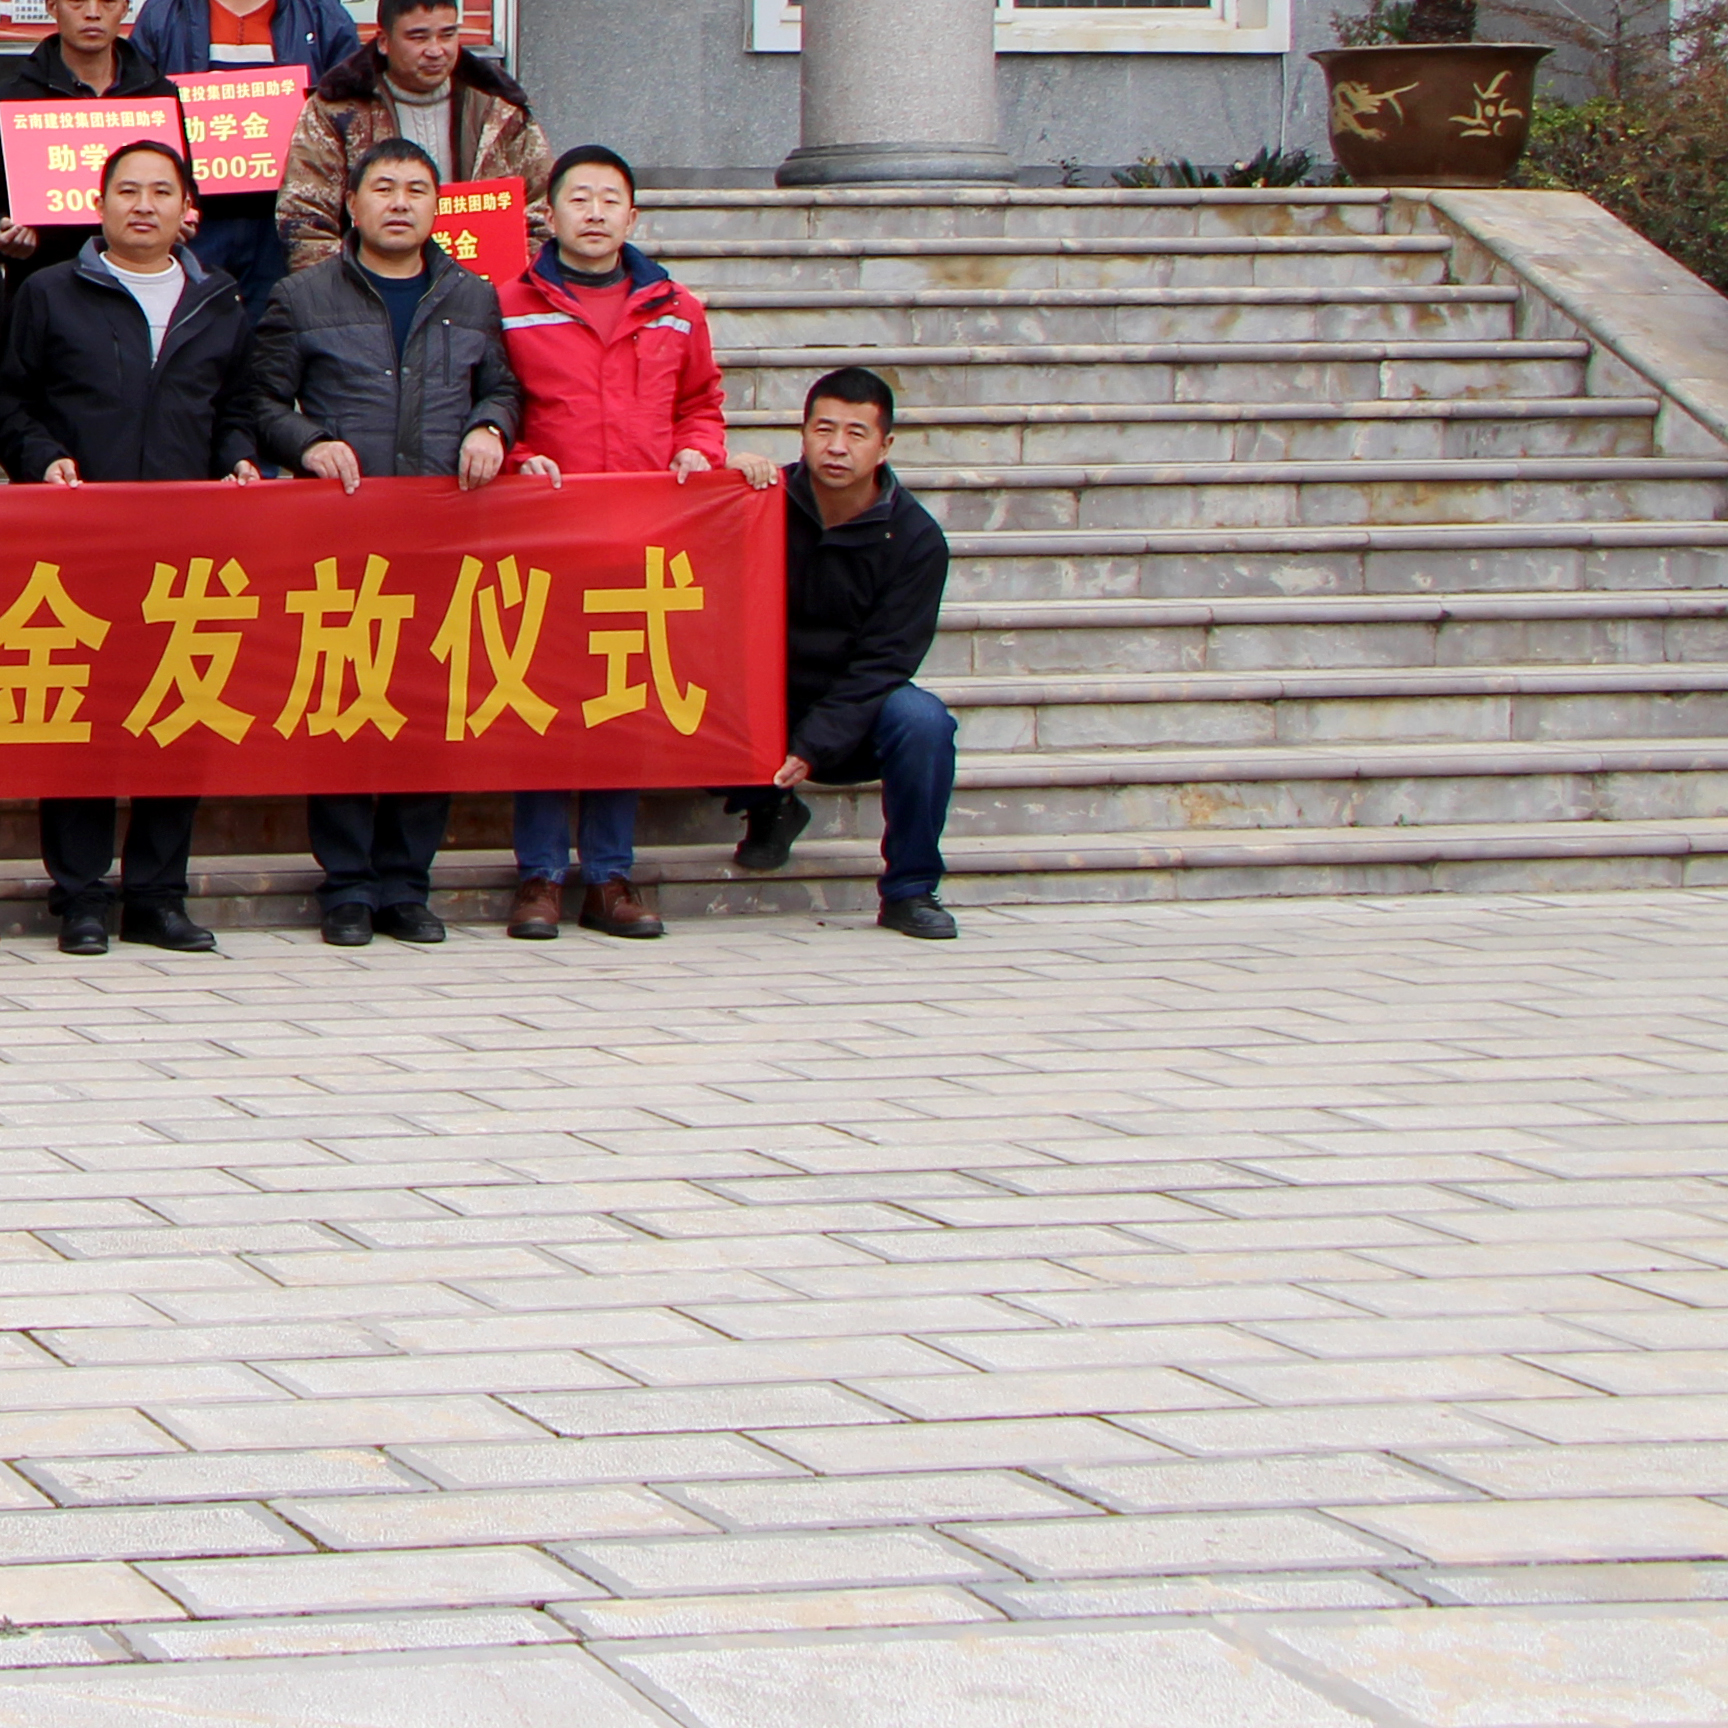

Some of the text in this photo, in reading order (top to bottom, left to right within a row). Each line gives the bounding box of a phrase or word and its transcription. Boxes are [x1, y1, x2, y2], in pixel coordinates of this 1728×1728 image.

[13, 110, 166, 129] 云南建投集团扶困助学
[434, 192, 511, 215] 团扶困助学
